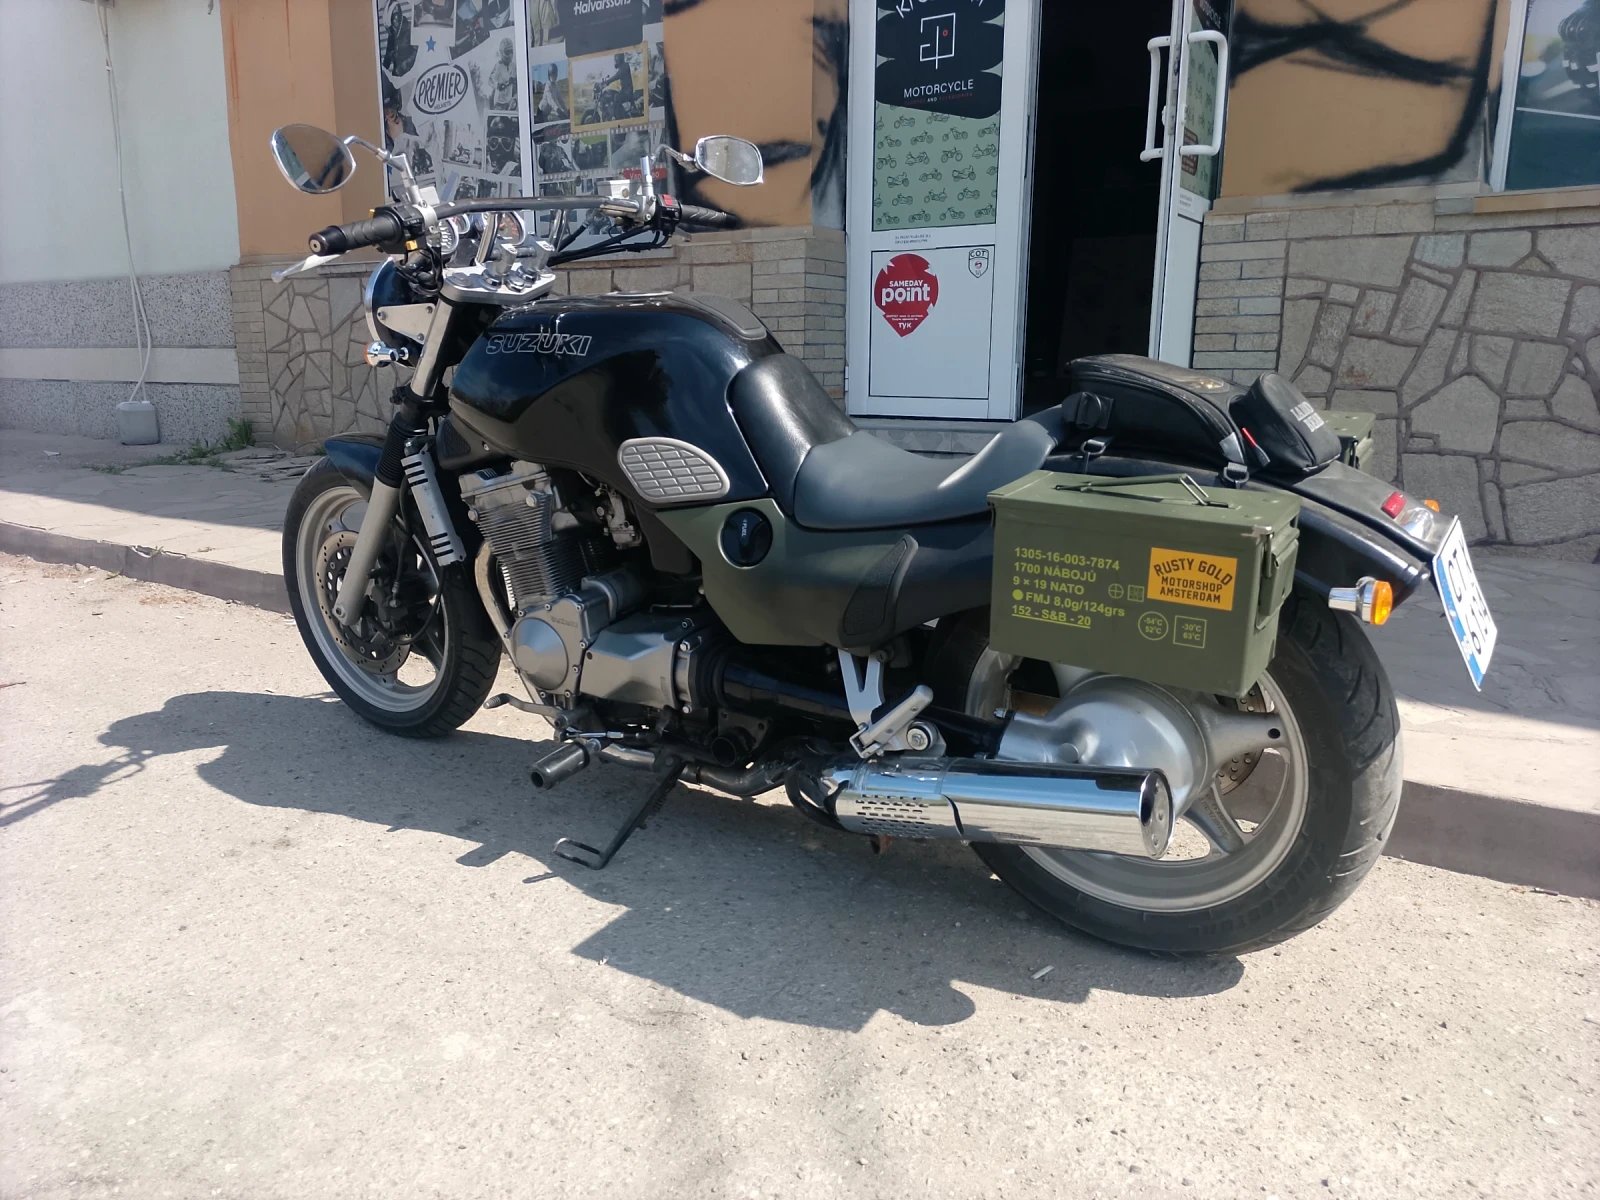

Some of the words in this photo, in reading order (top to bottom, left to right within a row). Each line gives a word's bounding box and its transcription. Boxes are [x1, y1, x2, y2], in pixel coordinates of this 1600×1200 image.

[573, 0, 631, 15] Halvarssons
[418, 72, 466, 108] PREMIER
[903, 79, 974, 98] MOTORCYCLE
[881, 283, 931, 306] point
[485, 333, 593, 357] SUZUKI
[1013, 562, 1041, 574] 1700
[1014, 547, 1120, 571] 1305-16-003-7874
[1153, 557, 1195, 577] RUSTY
[1197, 560, 1233, 586] GOLD
[1012, 576, 1020, 585] 9
[1033, 579, 1047, 589] 19
[1050, 581, 1085, 595] NATO
[1161, 576, 1223, 593] MOTORSHOP
[1025, 591, 1051, 604] FMJ
[1160, 586, 1221, 604] AMSTERDAM
[1012, 605, 1032, 616] 152
[1041, 609, 1067, 622] S&B
[1077, 615, 1092, 626] 20
